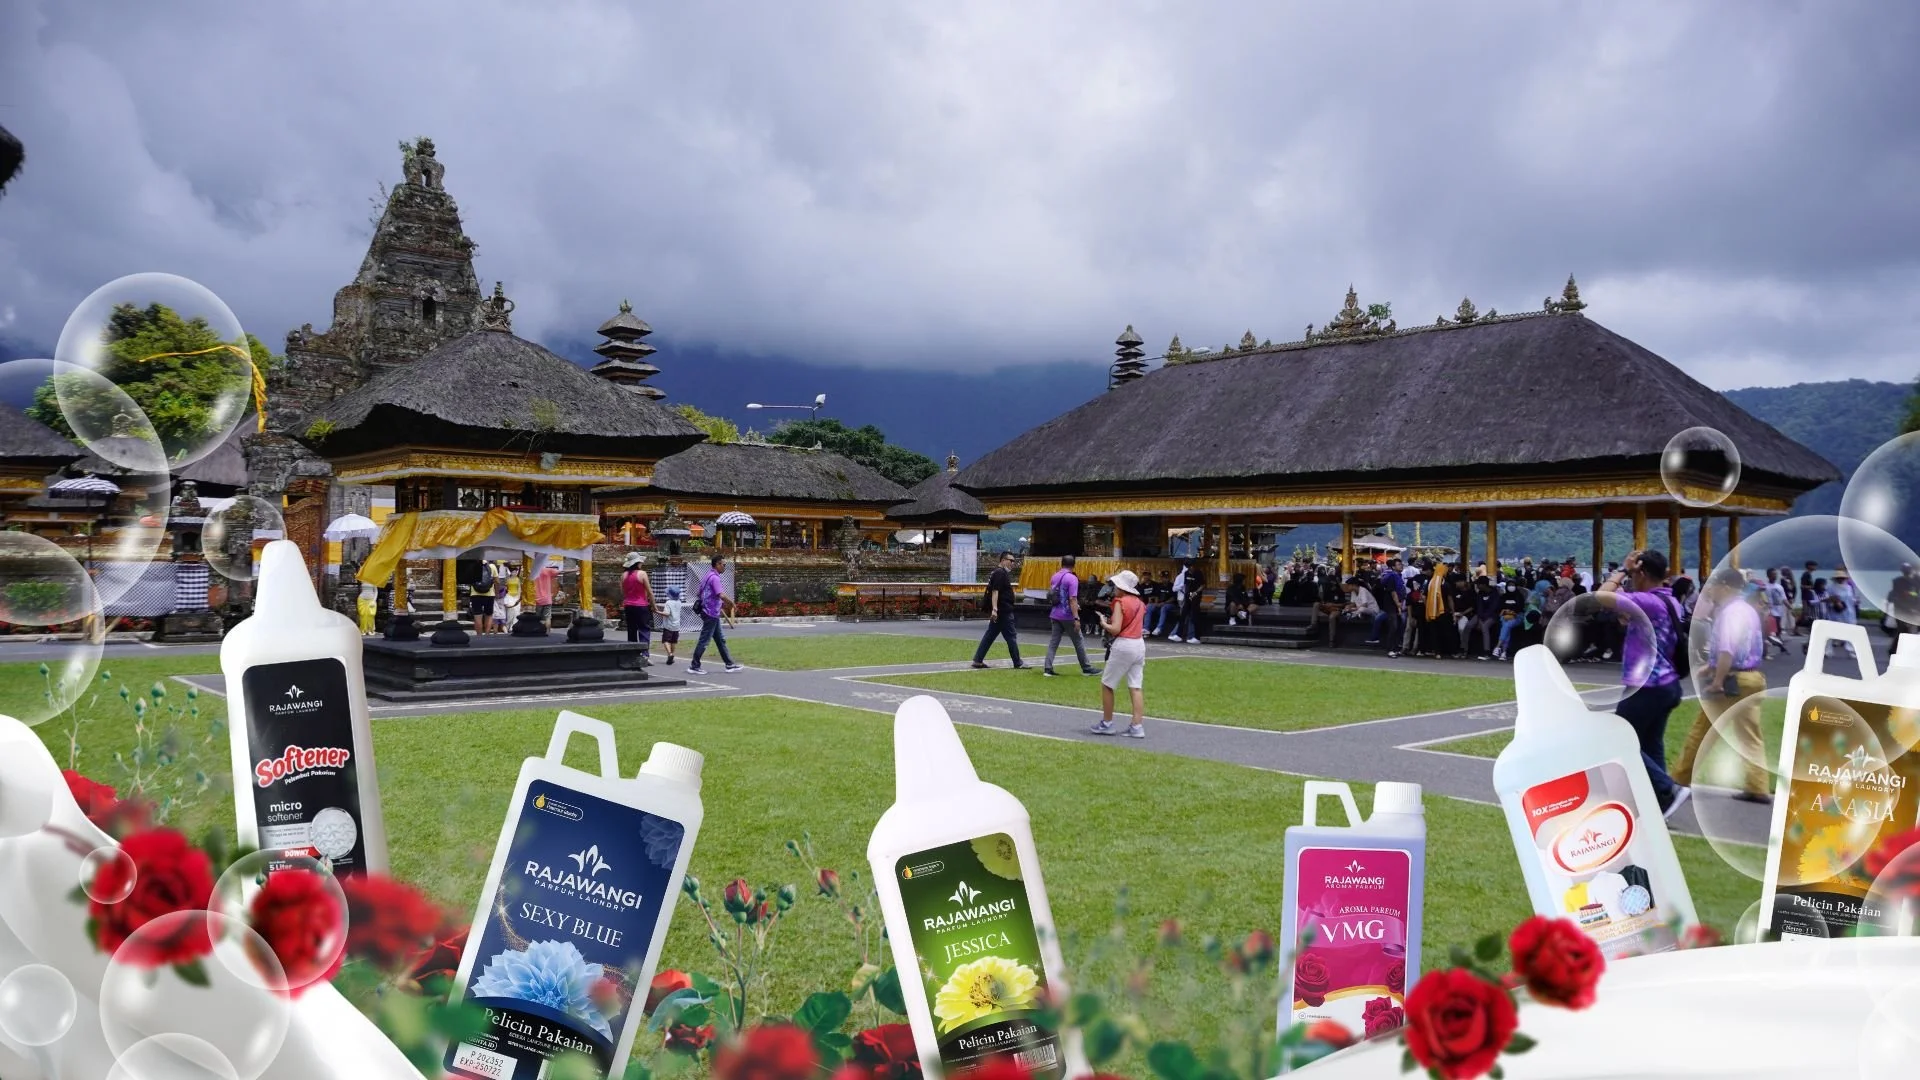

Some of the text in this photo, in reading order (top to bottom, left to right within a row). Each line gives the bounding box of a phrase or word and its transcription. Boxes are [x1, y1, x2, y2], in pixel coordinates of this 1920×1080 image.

[269, 700, 323, 712] RAJAWANGI
[256, 745, 350, 788] Softener
[1808, 763, 1906, 789] RAJAWANGI
[1856, 784, 1894, 793] LAUNDRY
[267, 812, 304, 822] softener
[270, 801, 302, 812] micro
[1532, 805, 1549, 817] 10X
[1570, 836, 1617, 858] RAJAWANGI
[524, 860, 642, 910] RAJAWANGI
[1324, 876, 1384, 884] RAJAWANGI
[534, 880, 626, 913] PARFUM LAUNDRY
[1793, 896, 1832, 910] Pelicin
[1837, 901, 1881, 918] Pakaian
[924, 898, 1016, 930] RAJAWANGI
[1340, 906, 1368, 914] AROMA
[520, 902, 624, 948] SEXY BLUE
[936, 913, 1008, 934] PARFUM LAUNDRY
[1320, 920, 1386, 944] VMG
[944, 932, 1011, 964] JESSICA
[483, 1008, 532, 1036] Pelicin
[538, 1026, 594, 1054] Pakaian
[958, 1035, 995, 1050] Pelicin
[997, 1025, 1038, 1040] Pakaian
